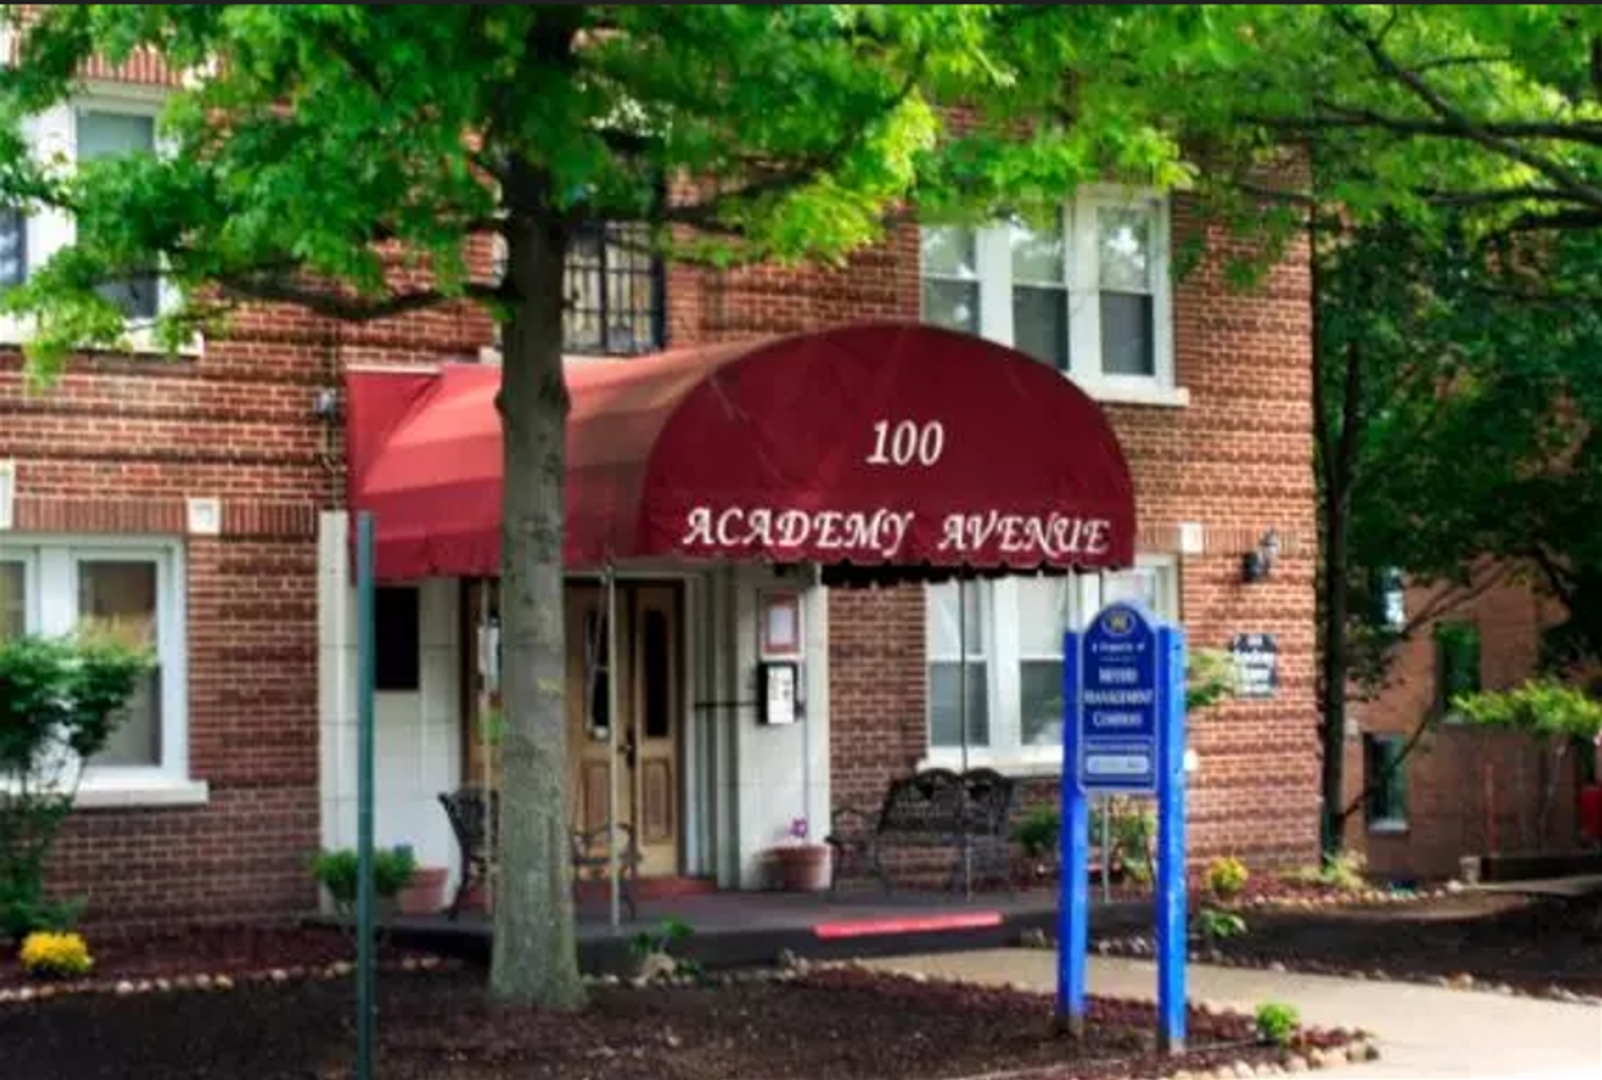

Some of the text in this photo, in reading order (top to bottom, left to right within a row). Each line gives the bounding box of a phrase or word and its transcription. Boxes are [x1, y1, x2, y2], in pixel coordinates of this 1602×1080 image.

[866, 419, 945, 466] 100
[683, 507, 1110, 558] ACADEMY AVENUE
